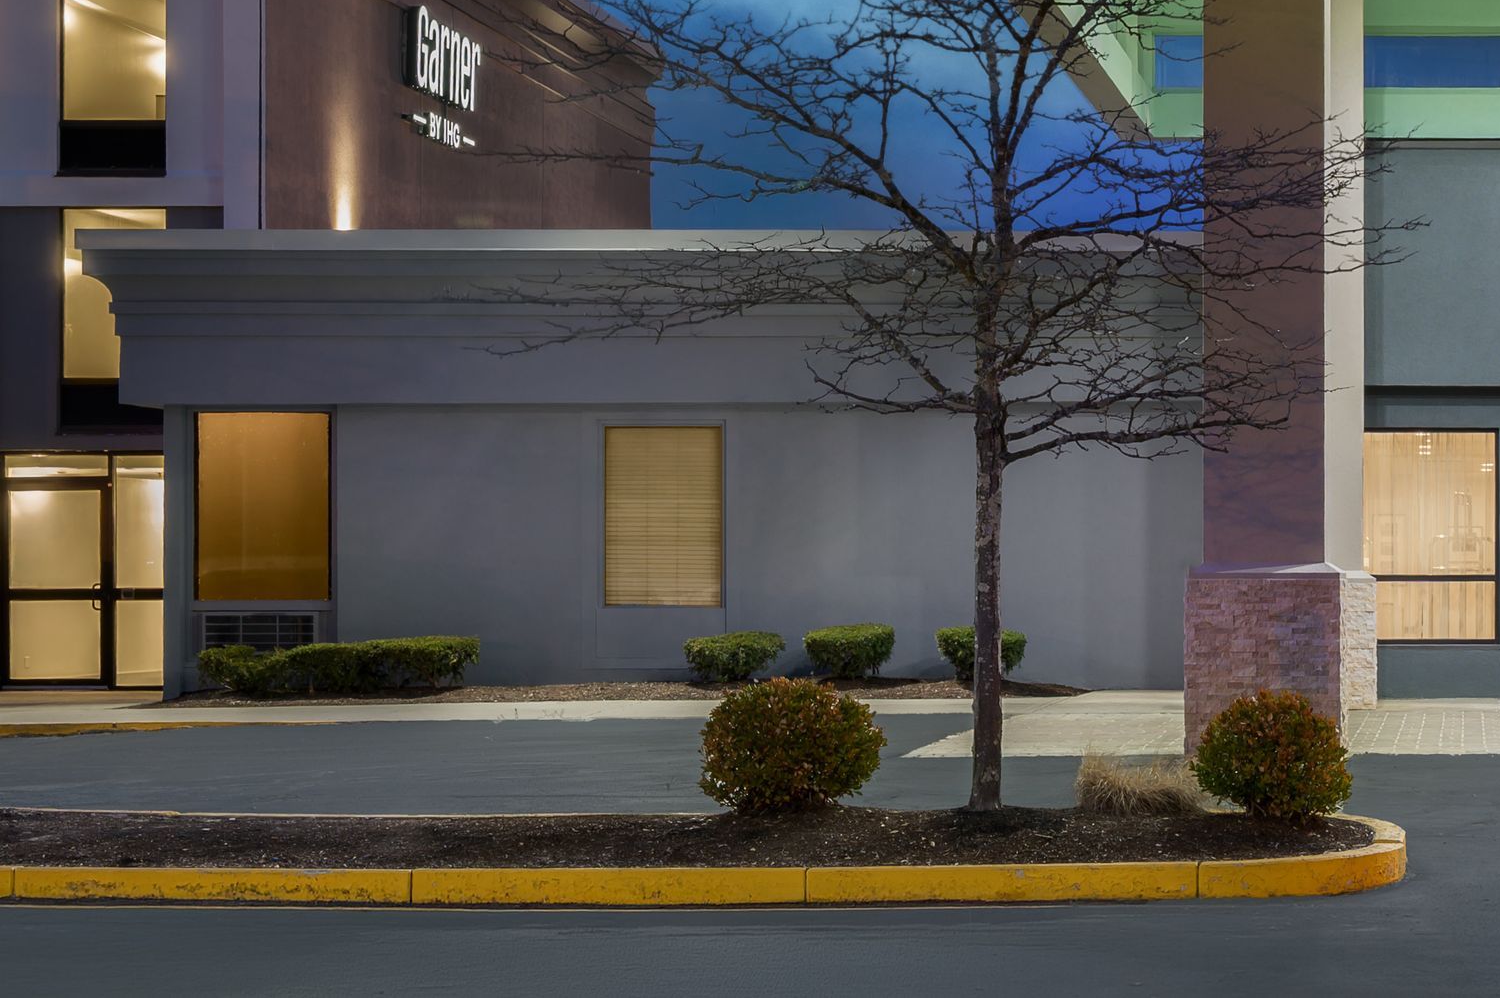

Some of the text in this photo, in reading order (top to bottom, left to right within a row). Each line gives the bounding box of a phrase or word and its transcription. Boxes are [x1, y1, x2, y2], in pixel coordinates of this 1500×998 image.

[416, 5, 481, 112] Garner
[429, 112, 460, 148] BY IHG
